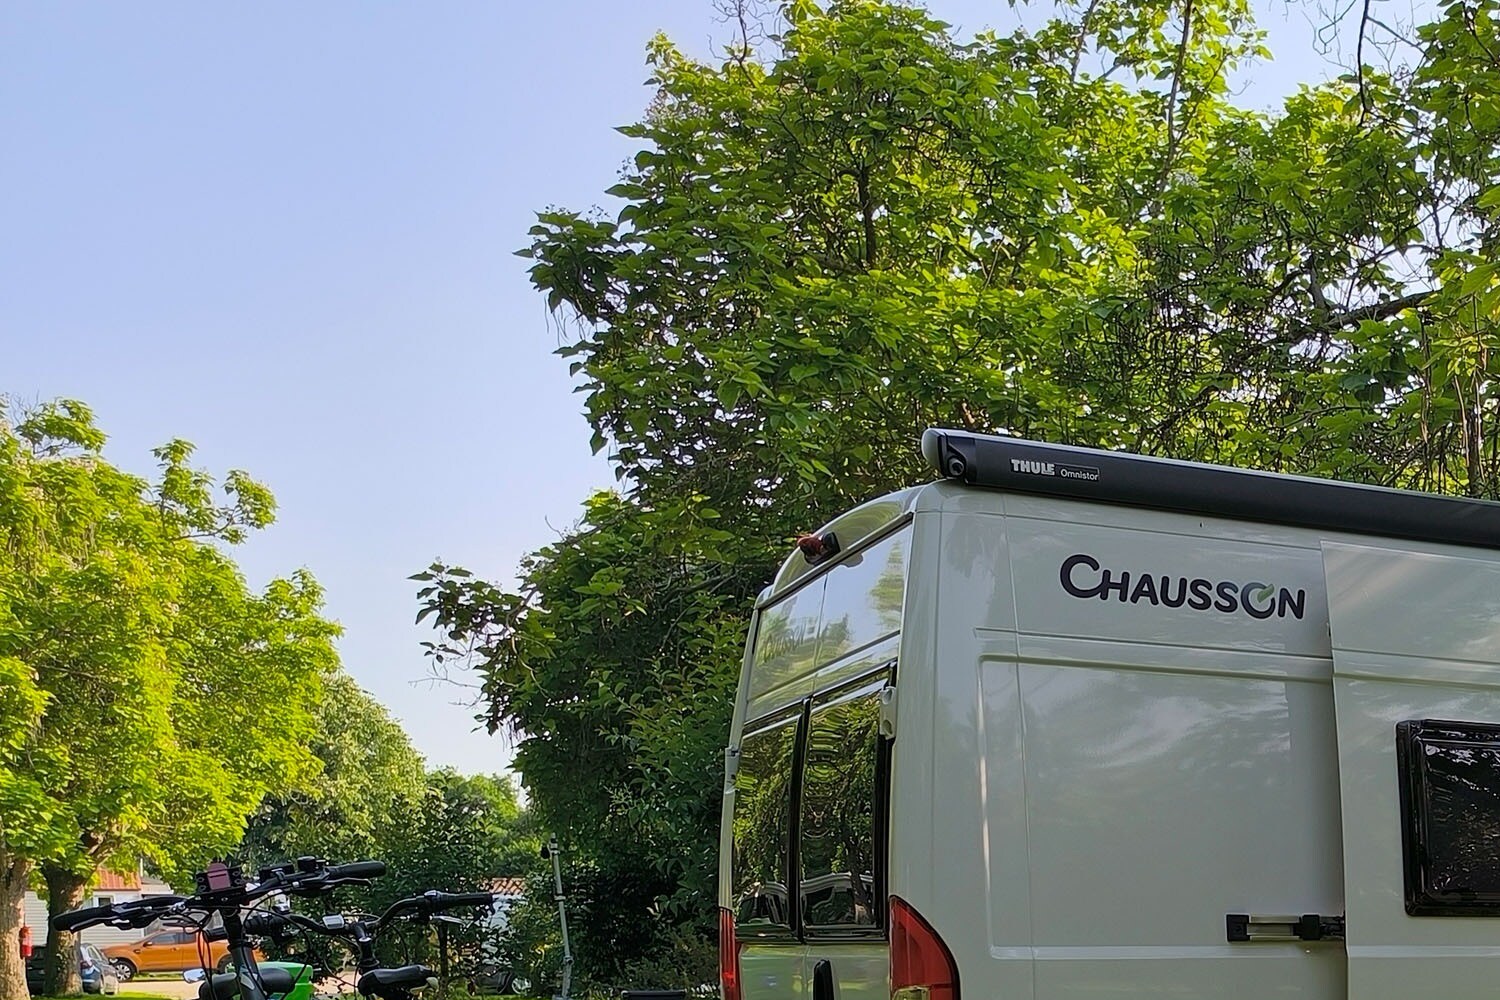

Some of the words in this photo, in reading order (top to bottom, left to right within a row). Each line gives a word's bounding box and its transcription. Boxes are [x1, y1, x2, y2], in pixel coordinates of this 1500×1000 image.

[1010, 459, 1055, 476] THULE
[1060, 467, 1099, 481] Omnistor
[1060, 554, 1305, 620] CHAUSSON
